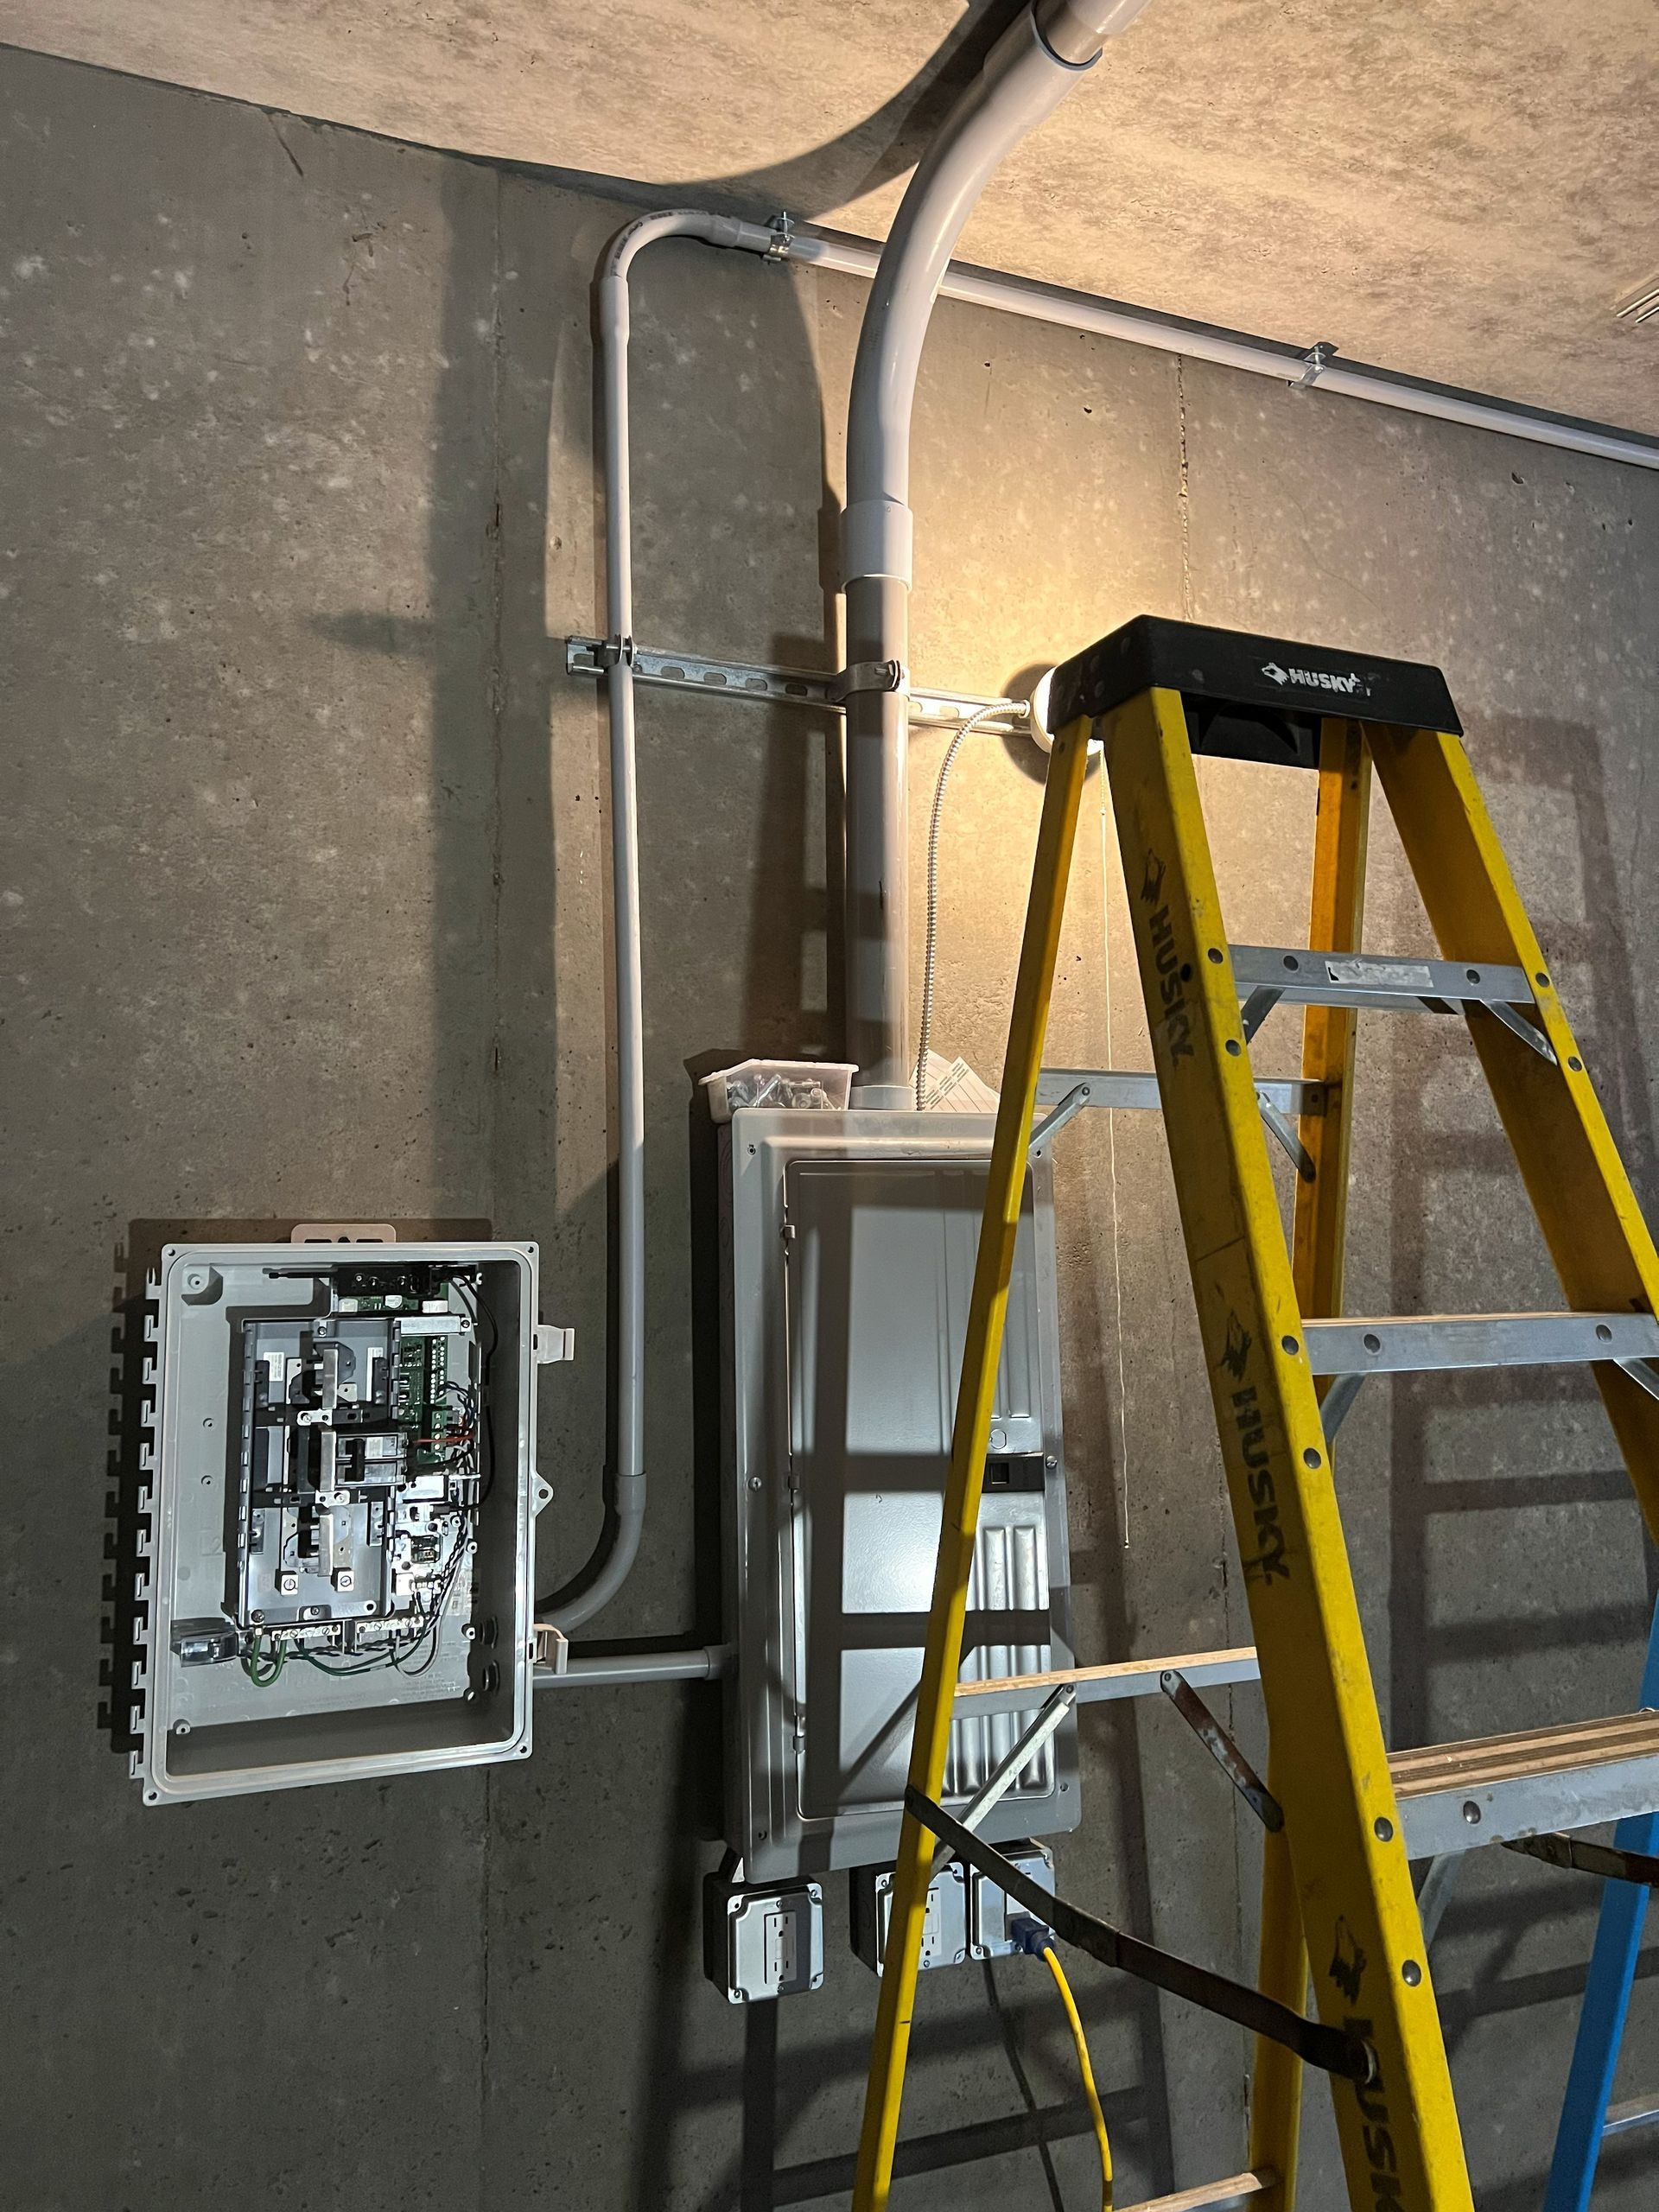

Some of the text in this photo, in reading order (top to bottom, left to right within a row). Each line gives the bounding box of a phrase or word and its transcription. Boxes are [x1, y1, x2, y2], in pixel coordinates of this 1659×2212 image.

[1288, 668, 1360, 693] HUSKY
[1148, 905, 1195, 1068] HUSKY
[1231, 1386, 1290, 1586] HUSKY
